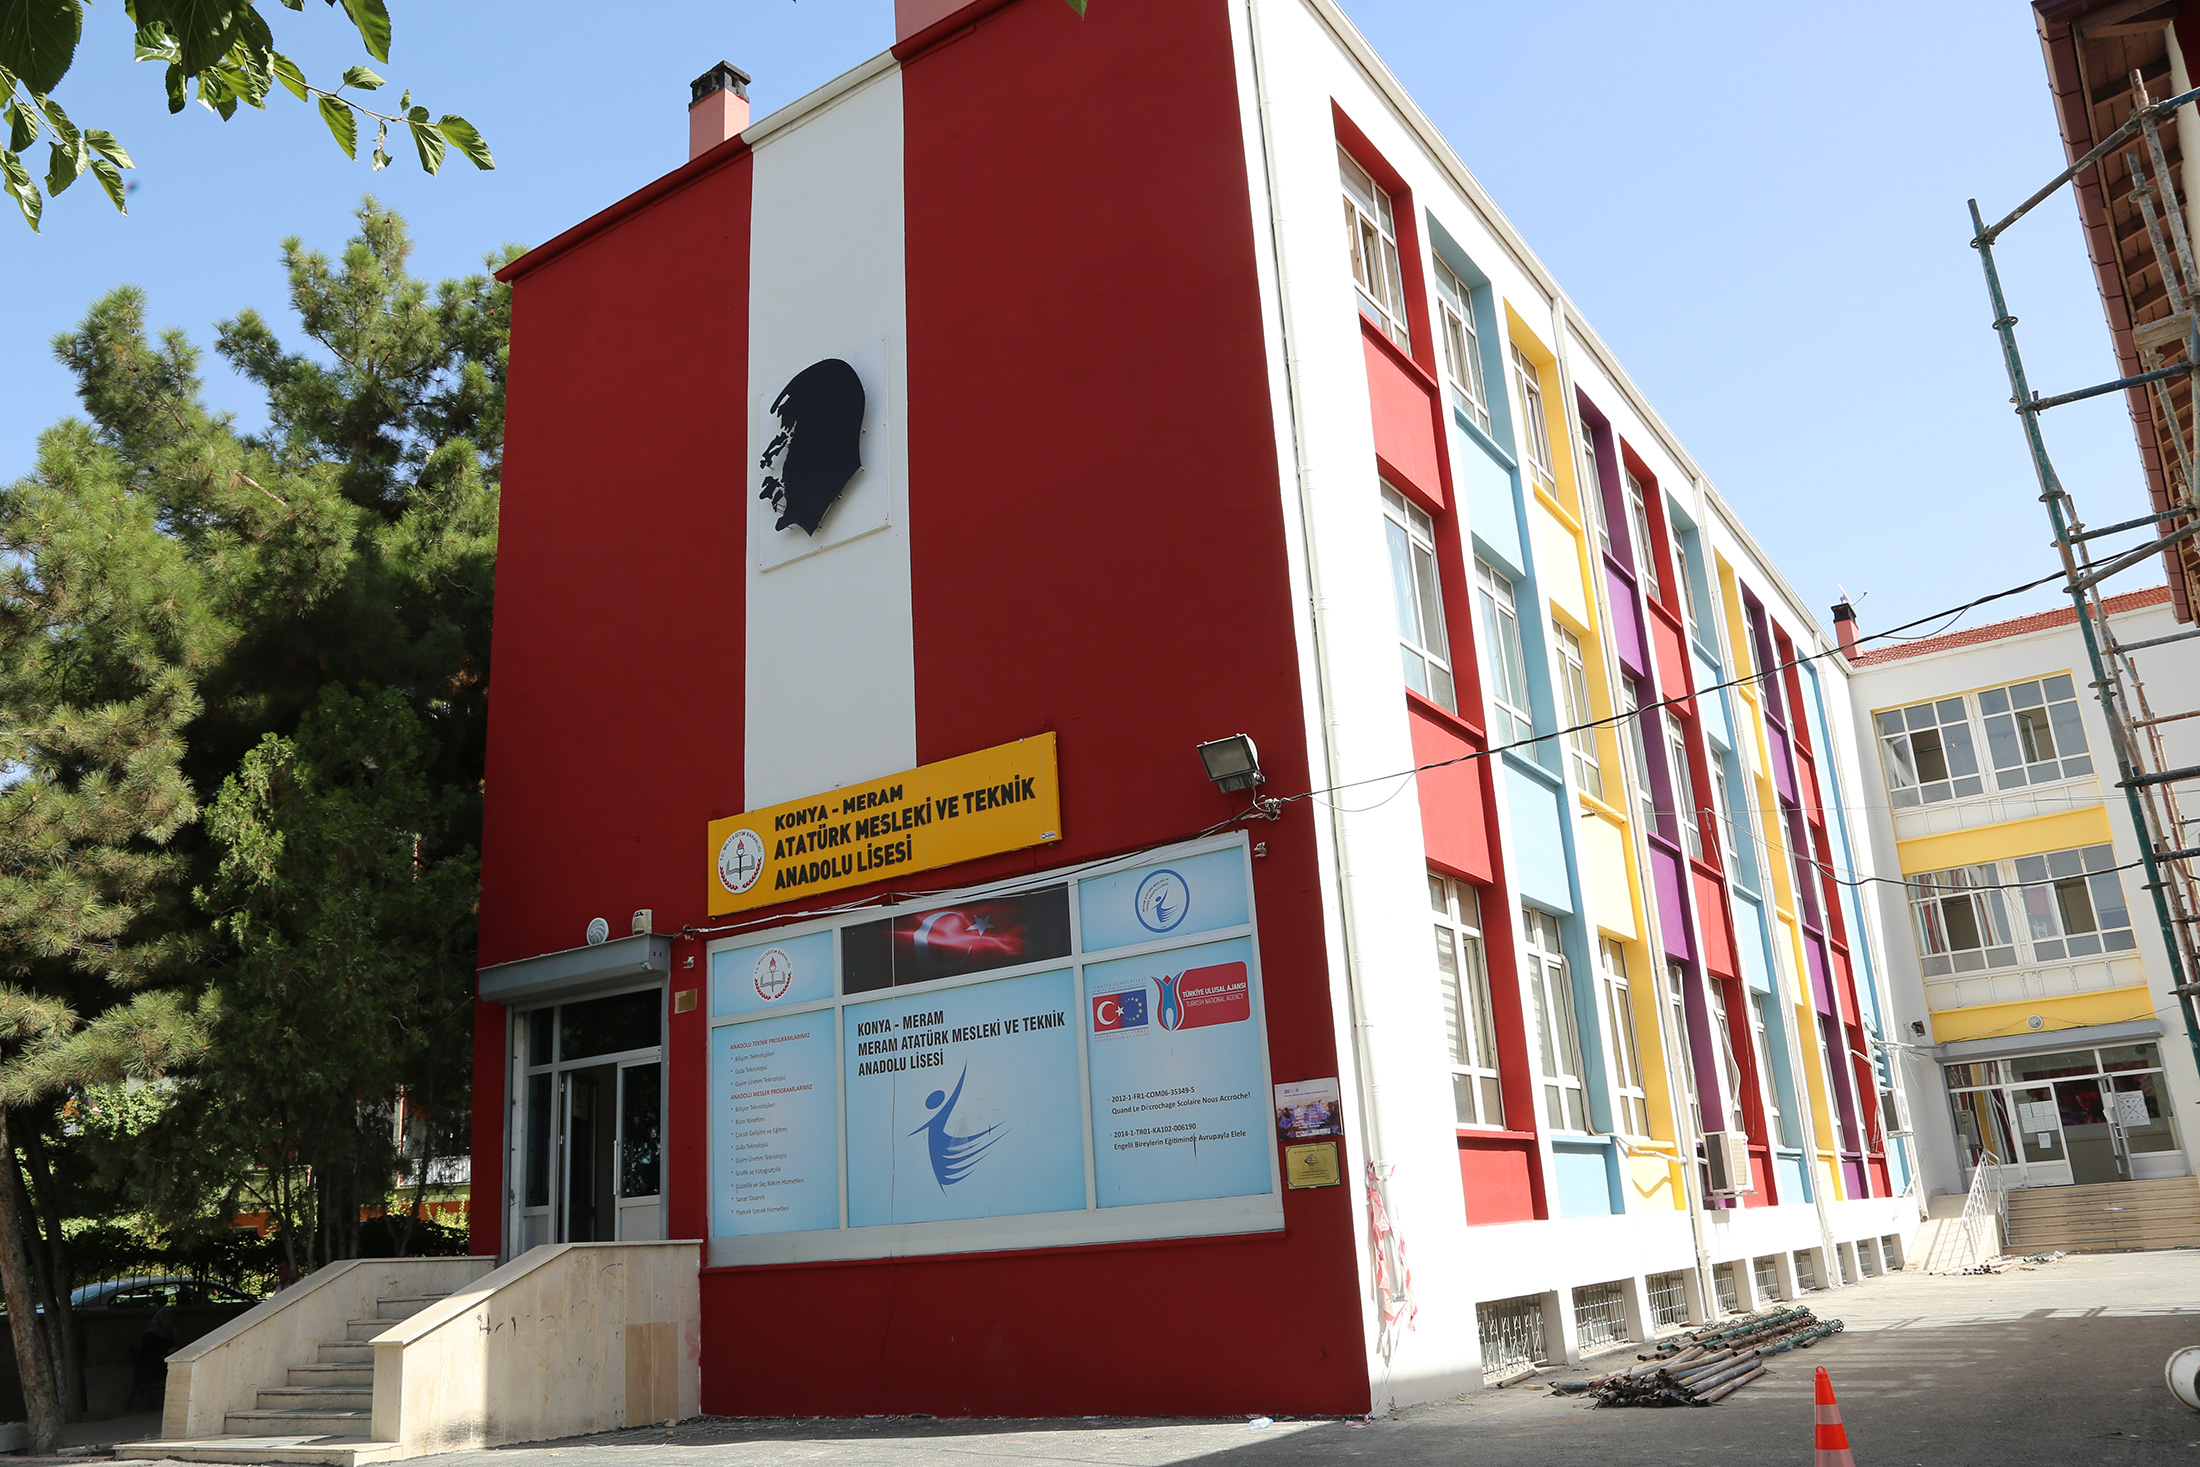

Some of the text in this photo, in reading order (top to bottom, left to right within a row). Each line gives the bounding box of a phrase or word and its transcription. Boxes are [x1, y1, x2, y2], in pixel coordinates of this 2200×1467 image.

[774, 804, 828, 831] KONYA
[842, 784, 903, 815] MERAM
[774, 774, 1036, 860] ATATÜRK MESLEKİ VE TEKNİK
[774, 833, 912, 891] ANADOLU LİSESİ
[1205, 985, 1226, 995] ULUSAL
[1227, 982, 1247, 991] AJANSI
[857, 1019, 892, 1037] KONYA
[902, 1010, 944, 1030] MERAM
[858, 1010, 1065, 1057] MERAM ATATÜRK MESLEKİ VE TEKNİK
[730, 1042, 752, 1050] ANADOLU
[858, 1049, 944, 1077] ANADOLU LİSESİ
[730, 1092, 752, 1100] ANADOLU
[1111, 1106, 1131, 1115] Quand
[1177, 1098, 1201, 1107] Scolaire
[1202, 1095, 1218, 1104] Nous
[1114, 1142, 1134, 1151] Engelli
[1134, 1139, 1164, 1149] Bireylerin
[1198, 1131, 1230, 1141] Avrupayla
[1231, 1130, 1247, 1138] Elele
